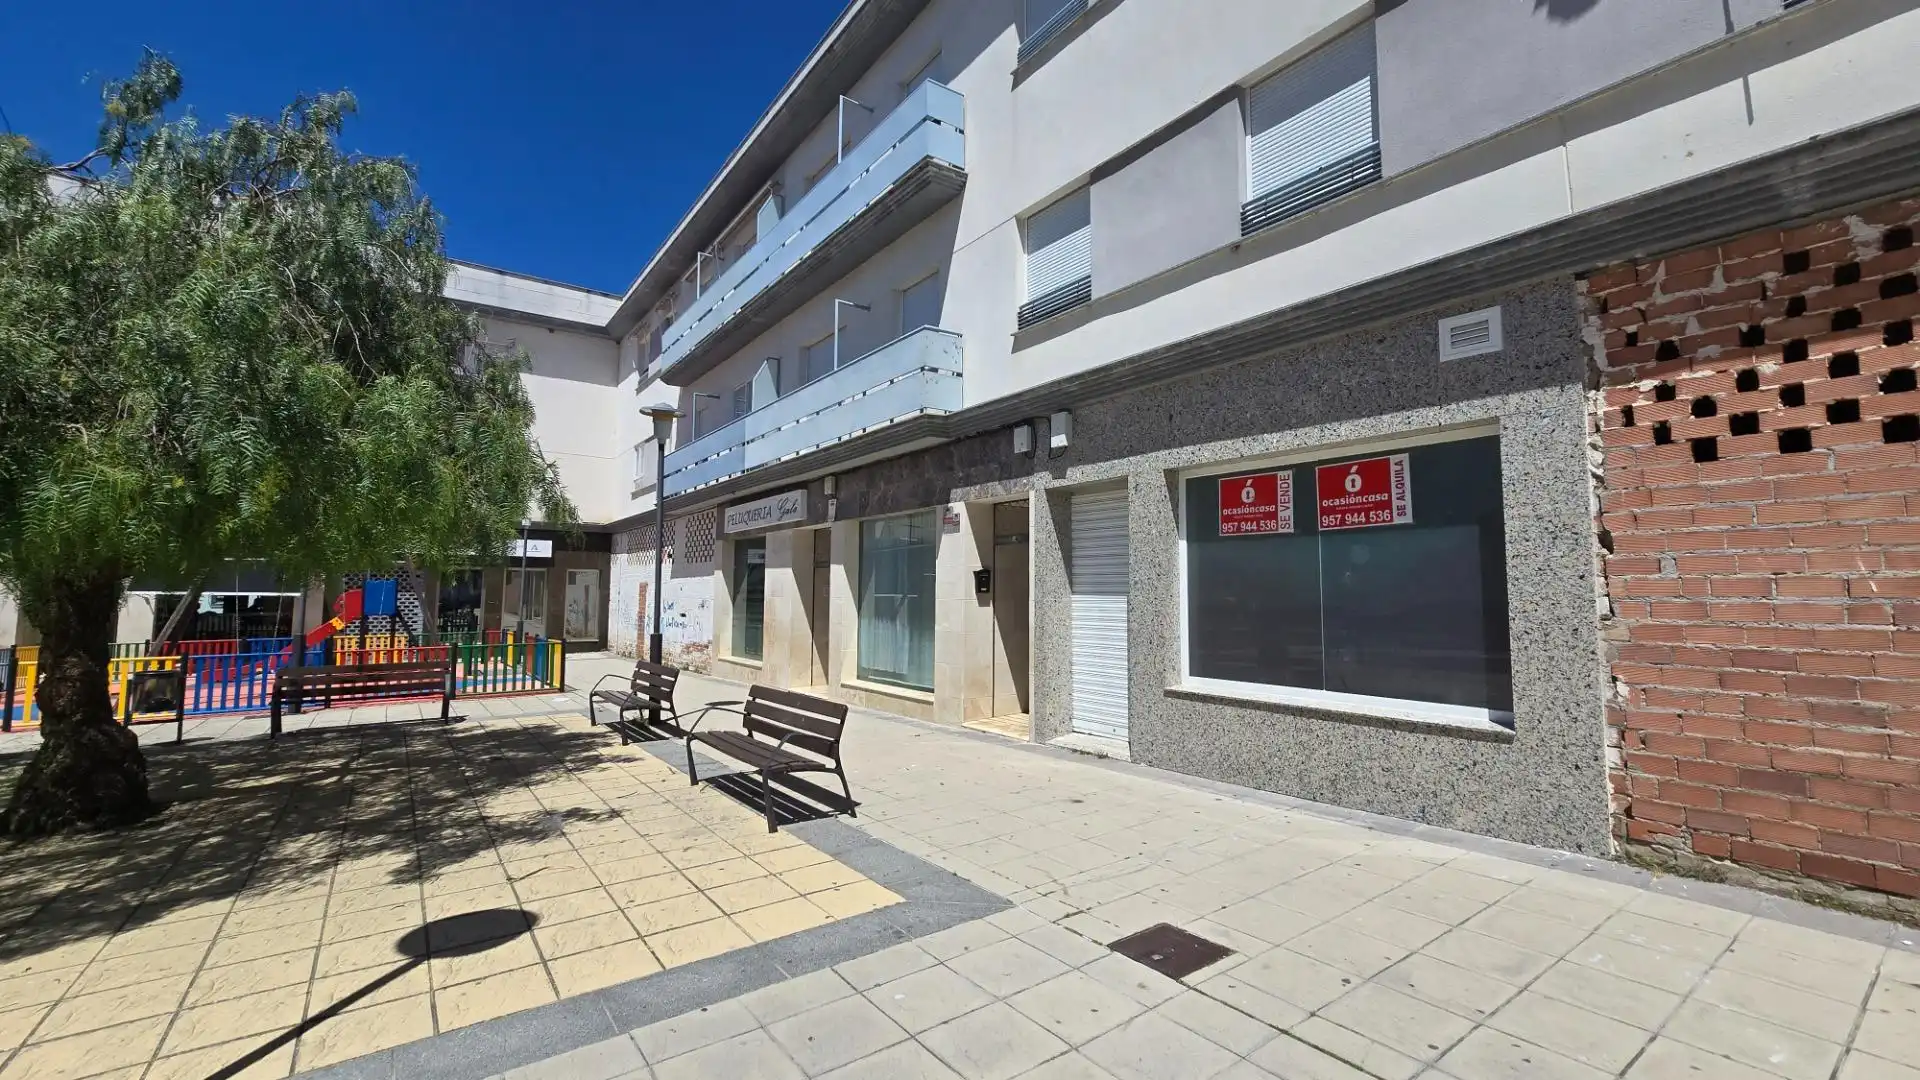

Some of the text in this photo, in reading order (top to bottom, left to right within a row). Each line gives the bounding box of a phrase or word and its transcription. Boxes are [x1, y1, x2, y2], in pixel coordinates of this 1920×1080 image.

[1394, 460, 1407, 517] SE ALQUILA
[1279, 474, 1291, 530] SE VENDE
[1322, 493, 1389, 507] ocasióncasa
[1222, 504, 1276, 515] ocasióncasa
[1322, 510, 1391, 526] 957 944 536
[1222, 519, 1277, 533] 957 944 536
